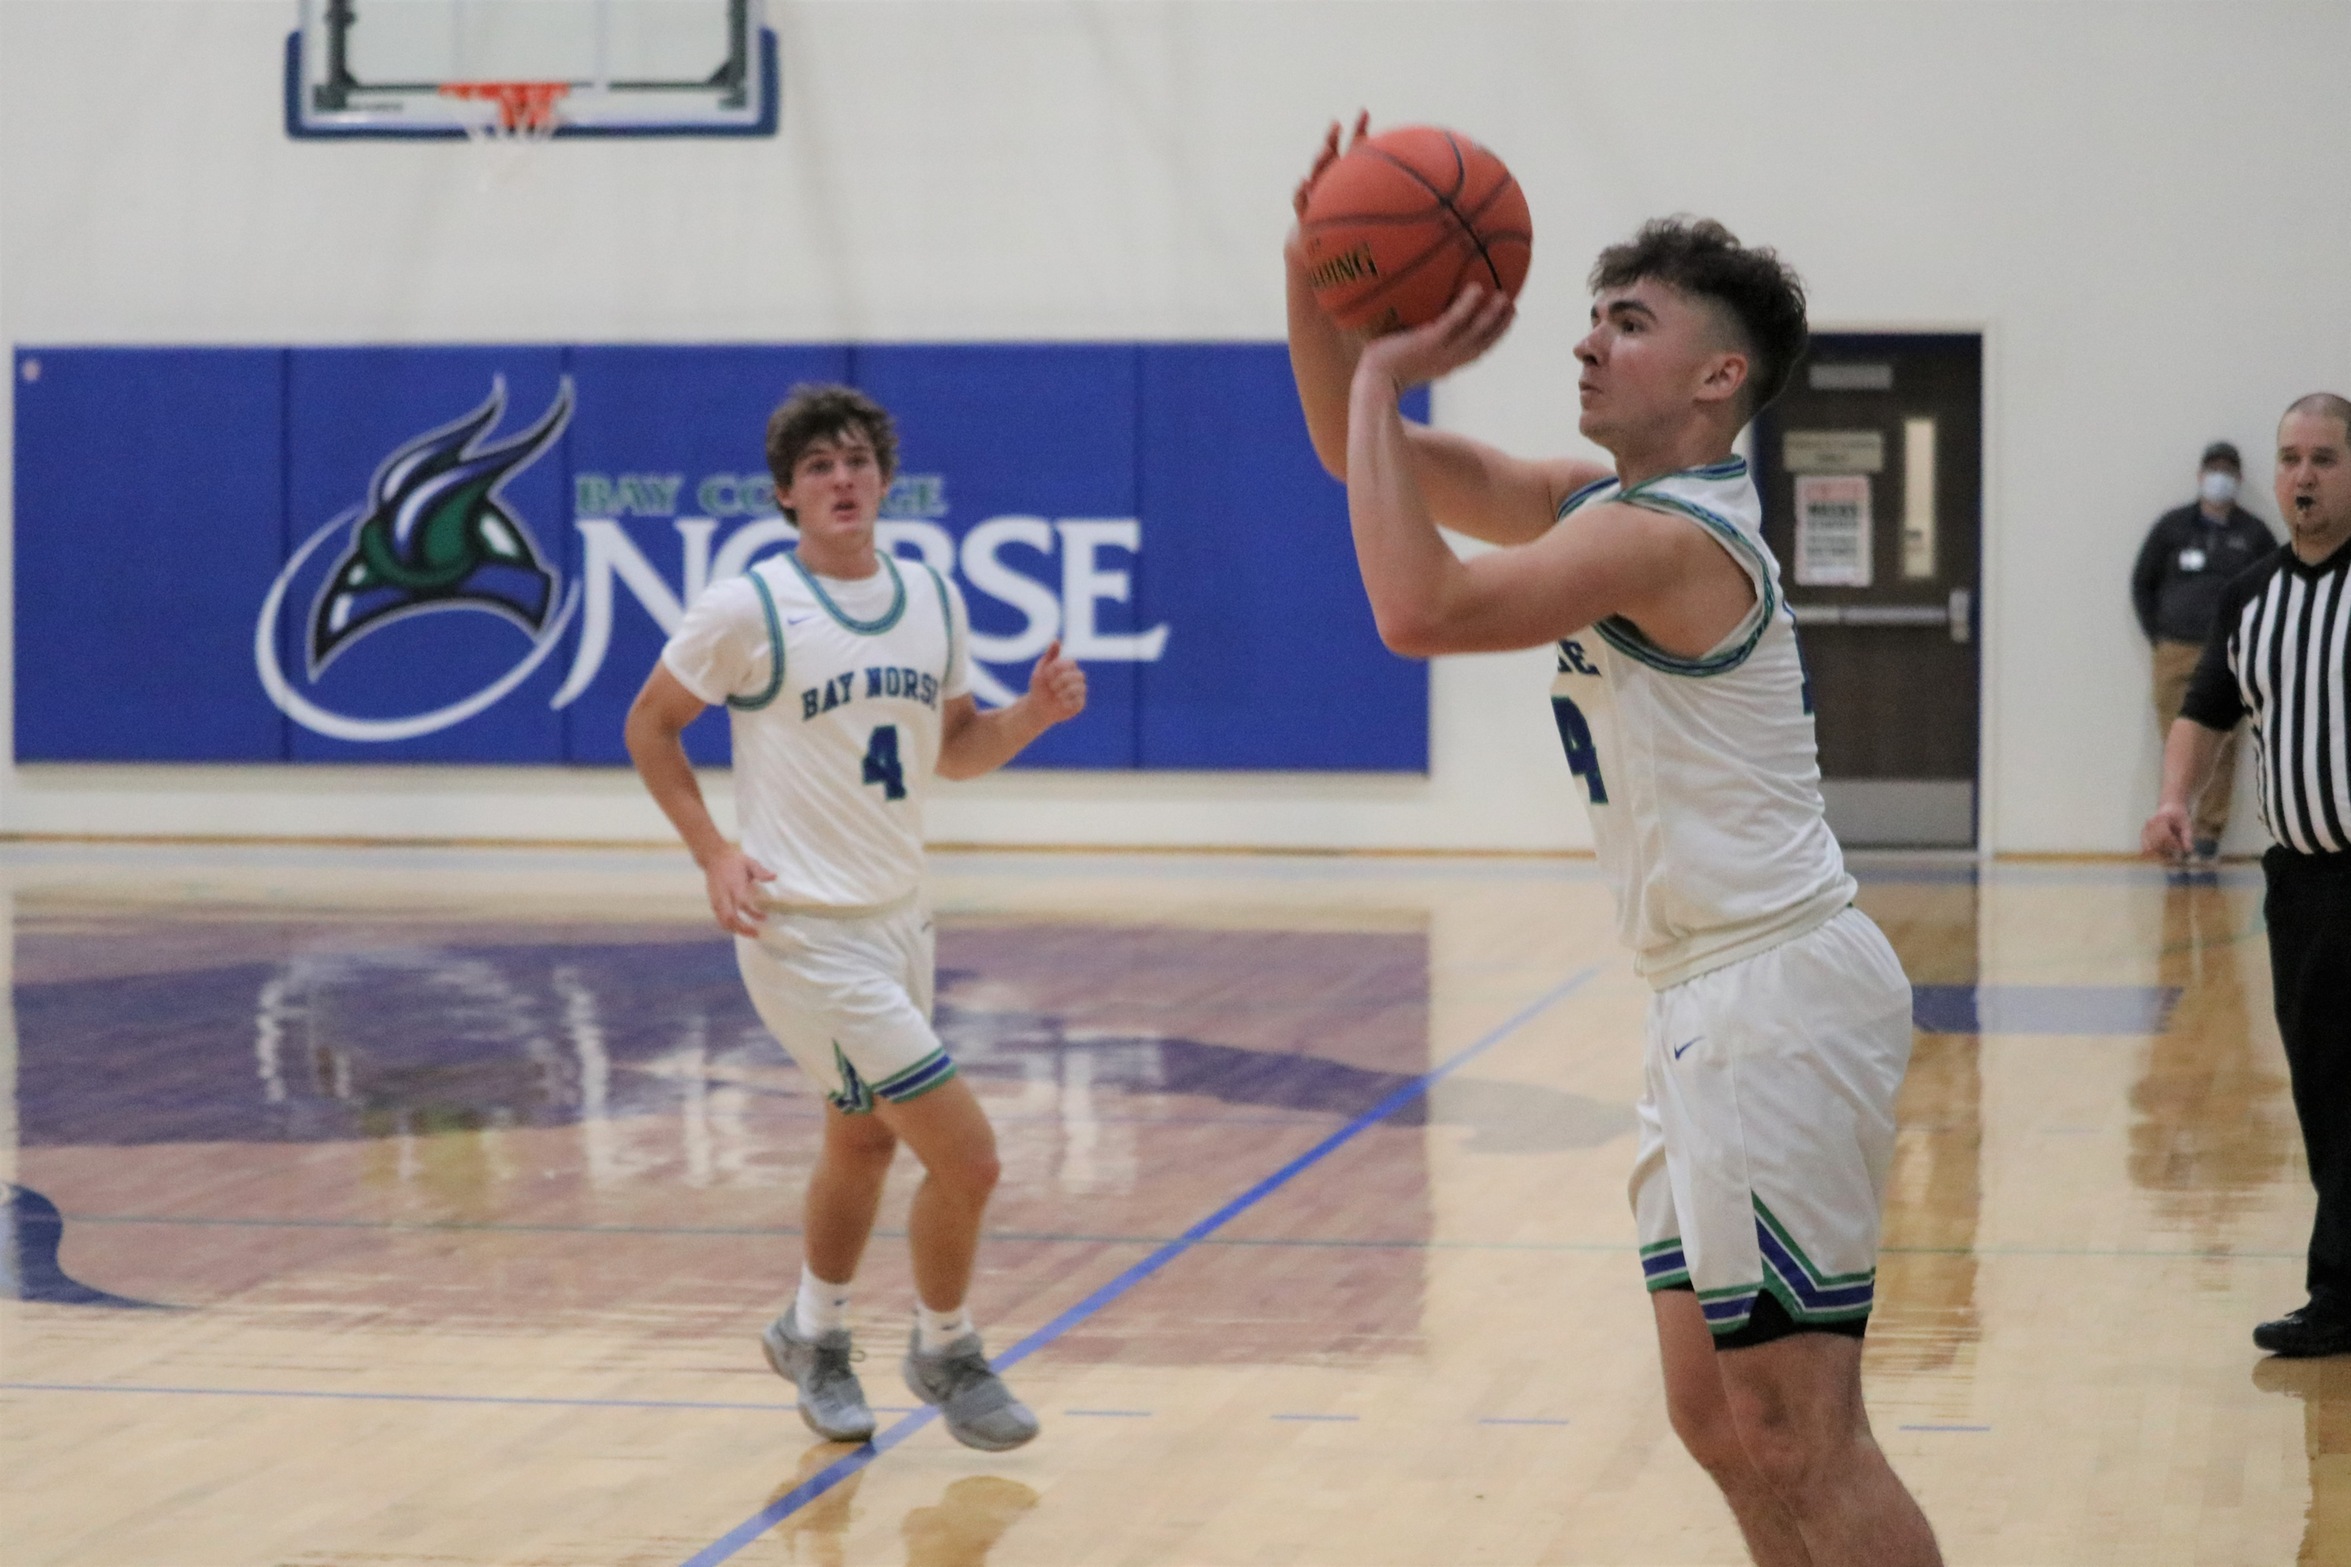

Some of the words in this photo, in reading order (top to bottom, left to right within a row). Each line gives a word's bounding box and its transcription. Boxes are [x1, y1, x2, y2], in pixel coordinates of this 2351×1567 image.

[575, 473, 683, 516] BAY
[698, 473, 947, 517] COGE
[801, 671, 855, 722] BAY
[861, 724, 907, 801] 4
